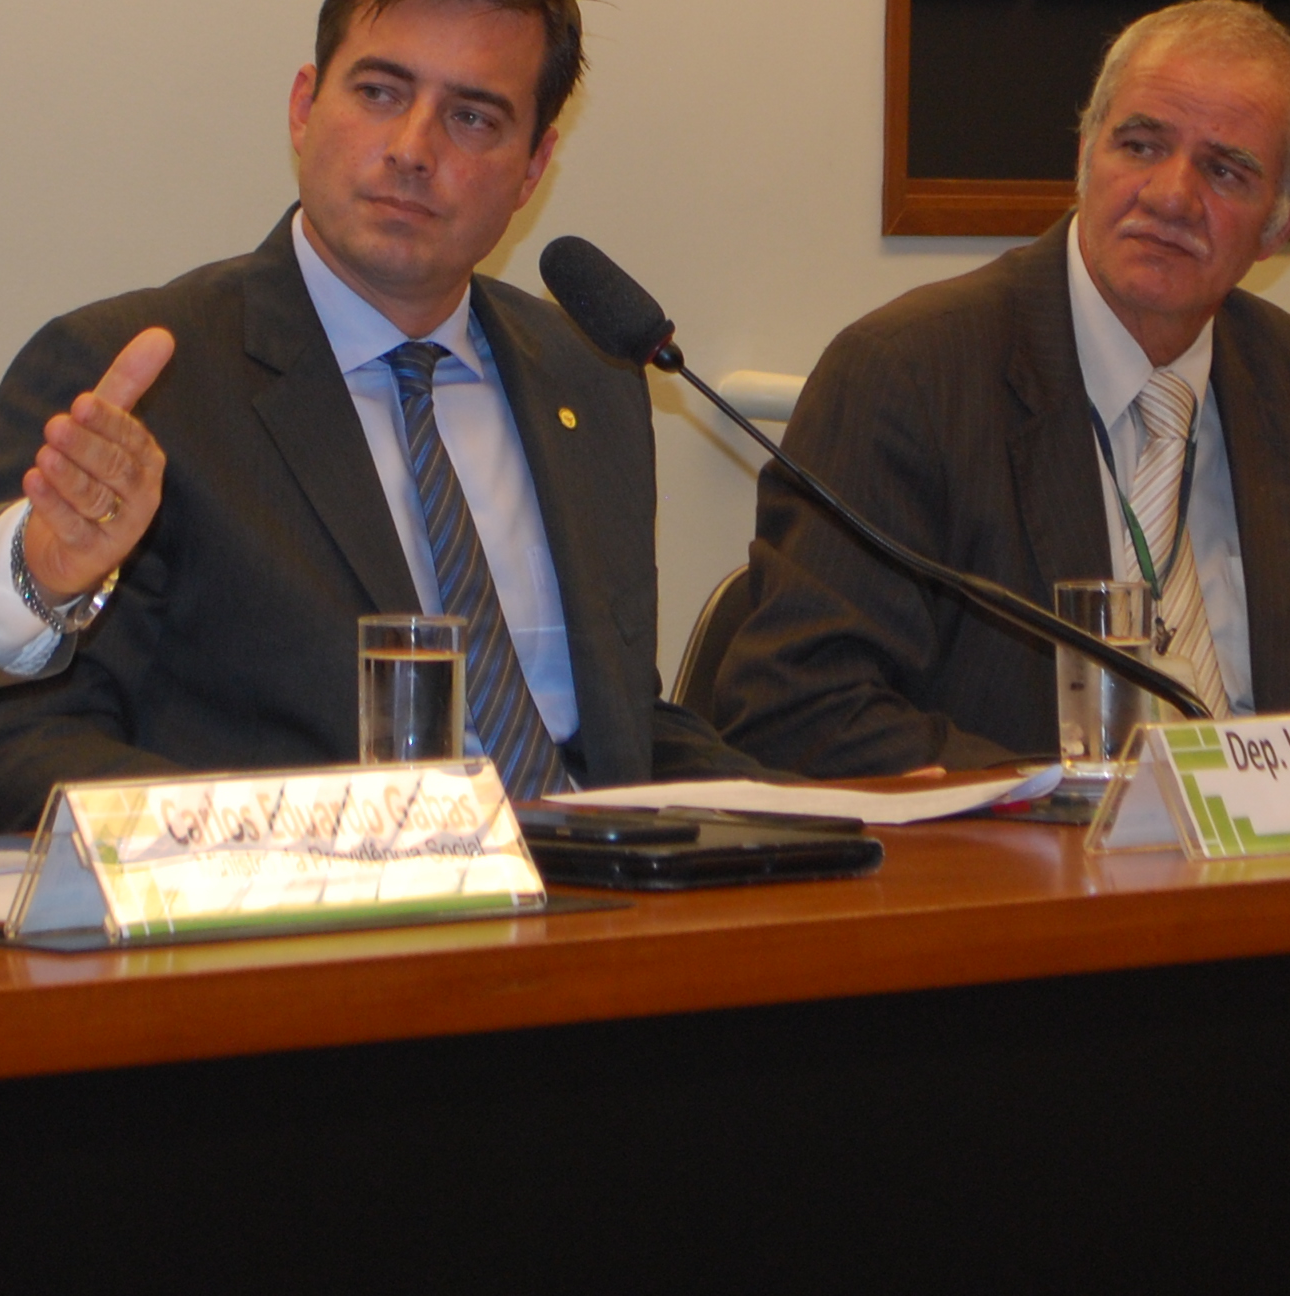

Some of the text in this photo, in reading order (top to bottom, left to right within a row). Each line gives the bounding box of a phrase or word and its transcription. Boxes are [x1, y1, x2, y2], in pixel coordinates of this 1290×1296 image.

[1225, 731, 1288, 781] Dep.
[160, 785, 478, 846] Carlos Eduardo Gabas
[425, 834, 485, 863] Social
